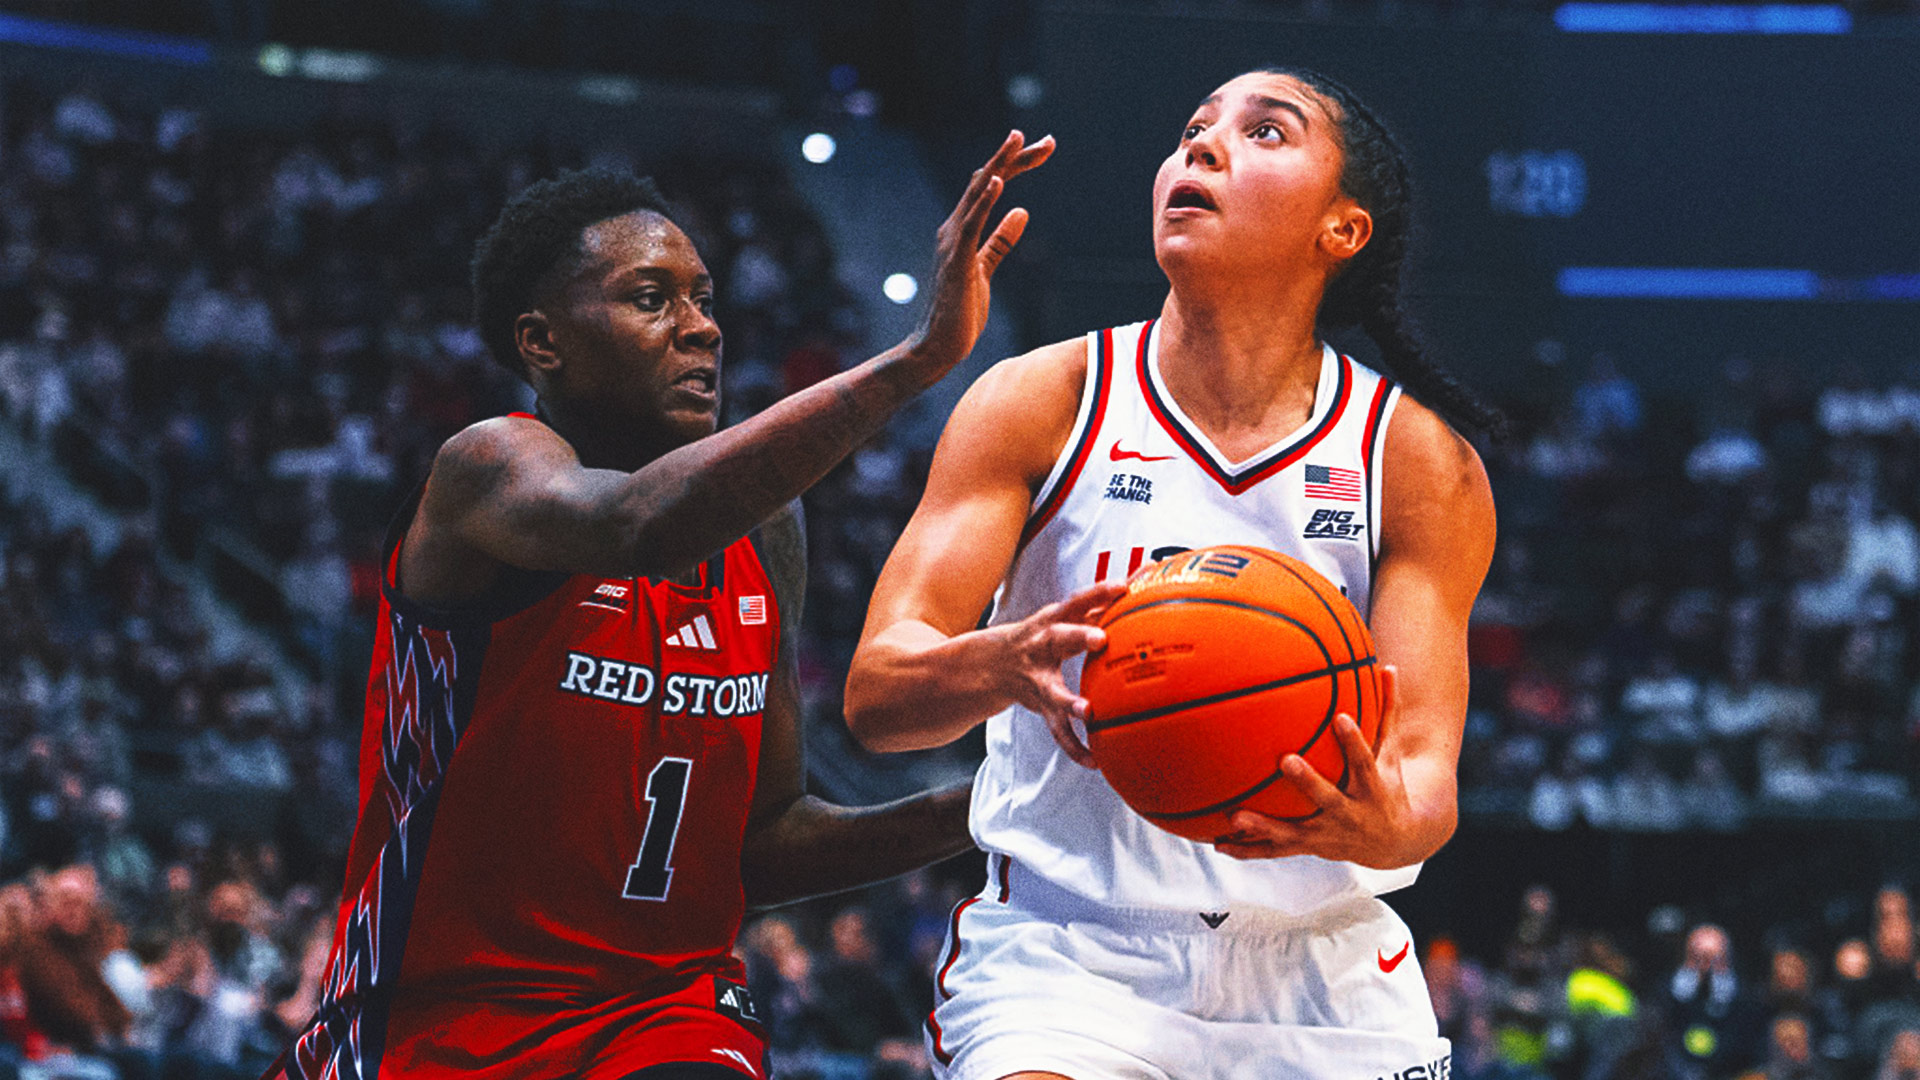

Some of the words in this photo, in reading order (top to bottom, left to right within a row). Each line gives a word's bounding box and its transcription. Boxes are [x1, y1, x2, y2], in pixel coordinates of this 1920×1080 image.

[1108, 473, 1127, 487] BE
[1129, 474, 1153, 492] THE
[1104, 486, 1153, 505] CHANGE
[1311, 508, 1356, 523] BIG
[1304, 521, 1365, 536] EAST
[594, 584, 628, 598] BIG
[560, 652, 656, 705] RED
[662, 673, 769, 716] STORM
[622, 755, 693, 902] 1
